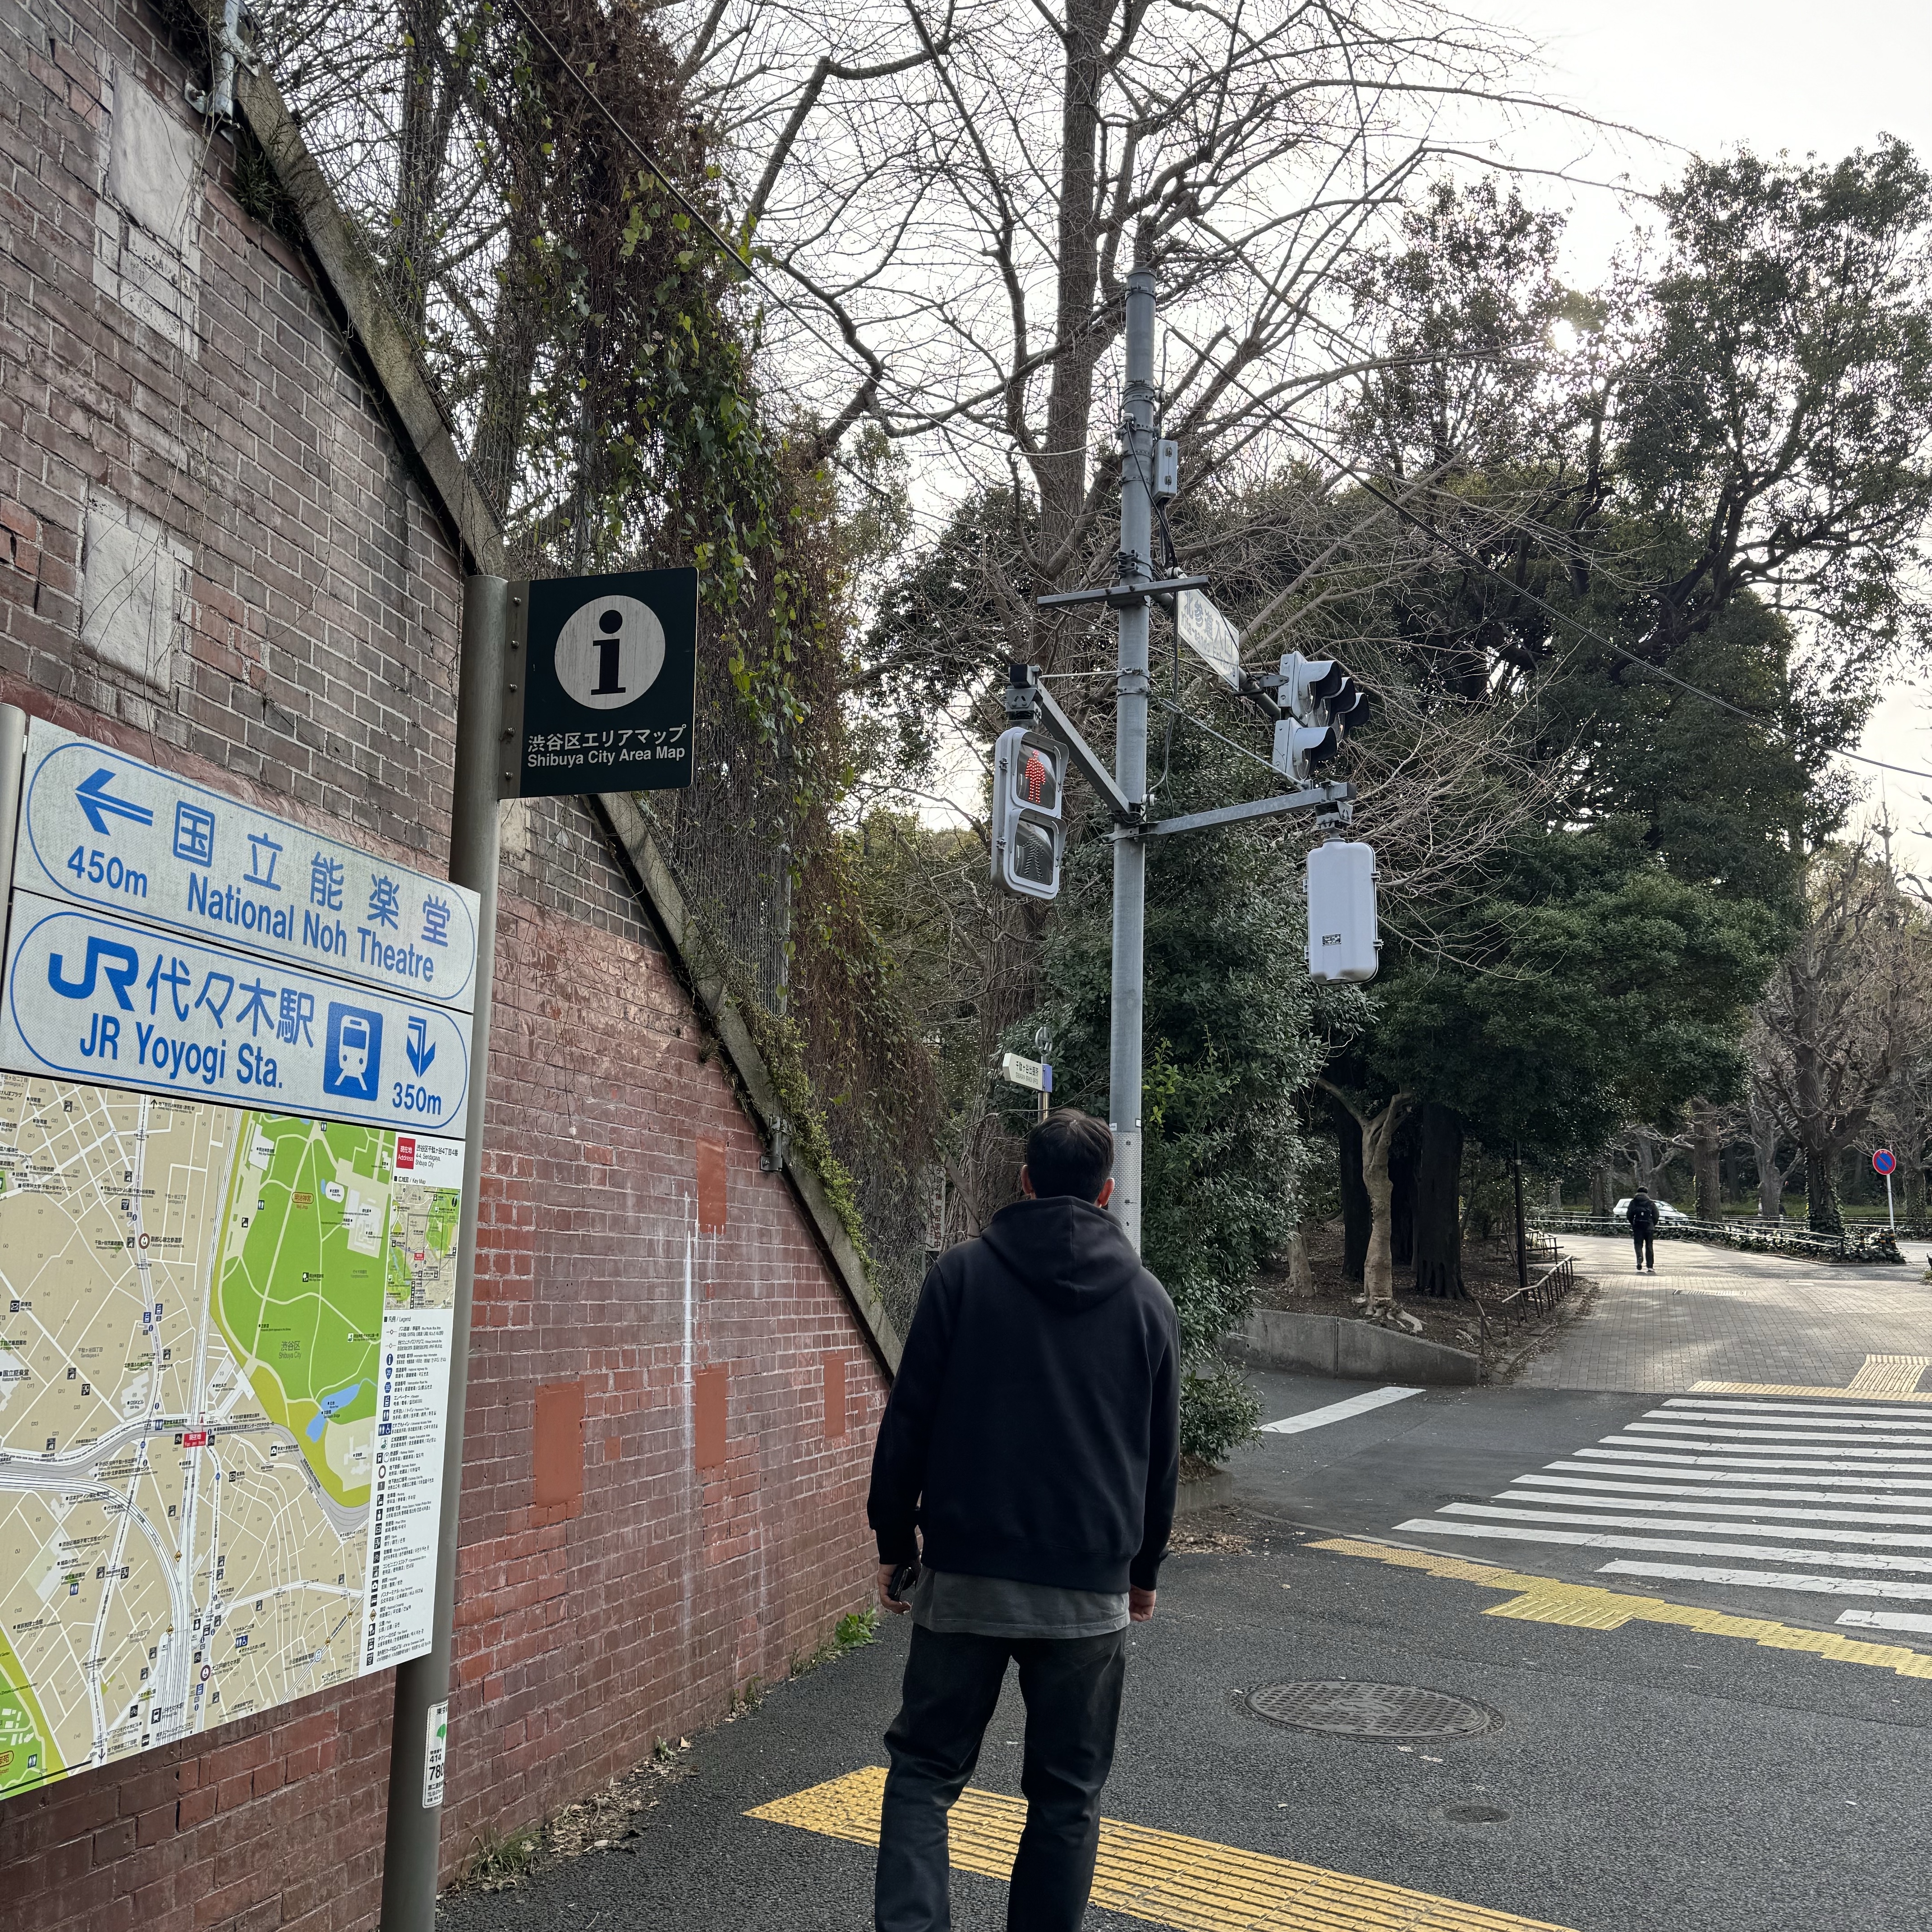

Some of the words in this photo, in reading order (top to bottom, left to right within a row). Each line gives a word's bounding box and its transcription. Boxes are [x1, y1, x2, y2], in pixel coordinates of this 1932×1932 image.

[1181, 611, 1210, 653] Kita-sando
[1213, 645, 1235, 677] Entrance
[528, 724, 686, 752] 渋谷区エリアマップ
[528, 754, 583, 768] Shibuya
[589, 751, 615, 765] City
[619, 749, 651, 761] Area
[657, 746, 685, 761] Map
[67, 846, 147, 897] 450m
[173, 801, 450, 947] 国立能楽堂
[188, 873, 294, 940] National
[303, 911, 346, 956] Noh
[357, 927, 433, 981] Theatre
[80, 1013, 120, 1060] JR
[136, 1021, 226, 1085] Yoyogi
[237, 1043, 282, 1088] Sta.
[392, 1082, 442, 1114] 350m
[281, 1341, 300, 1351] 渋谷区
[437, 1706, 447, 1716] 東京
[430, 1753, 441, 1763] 414
